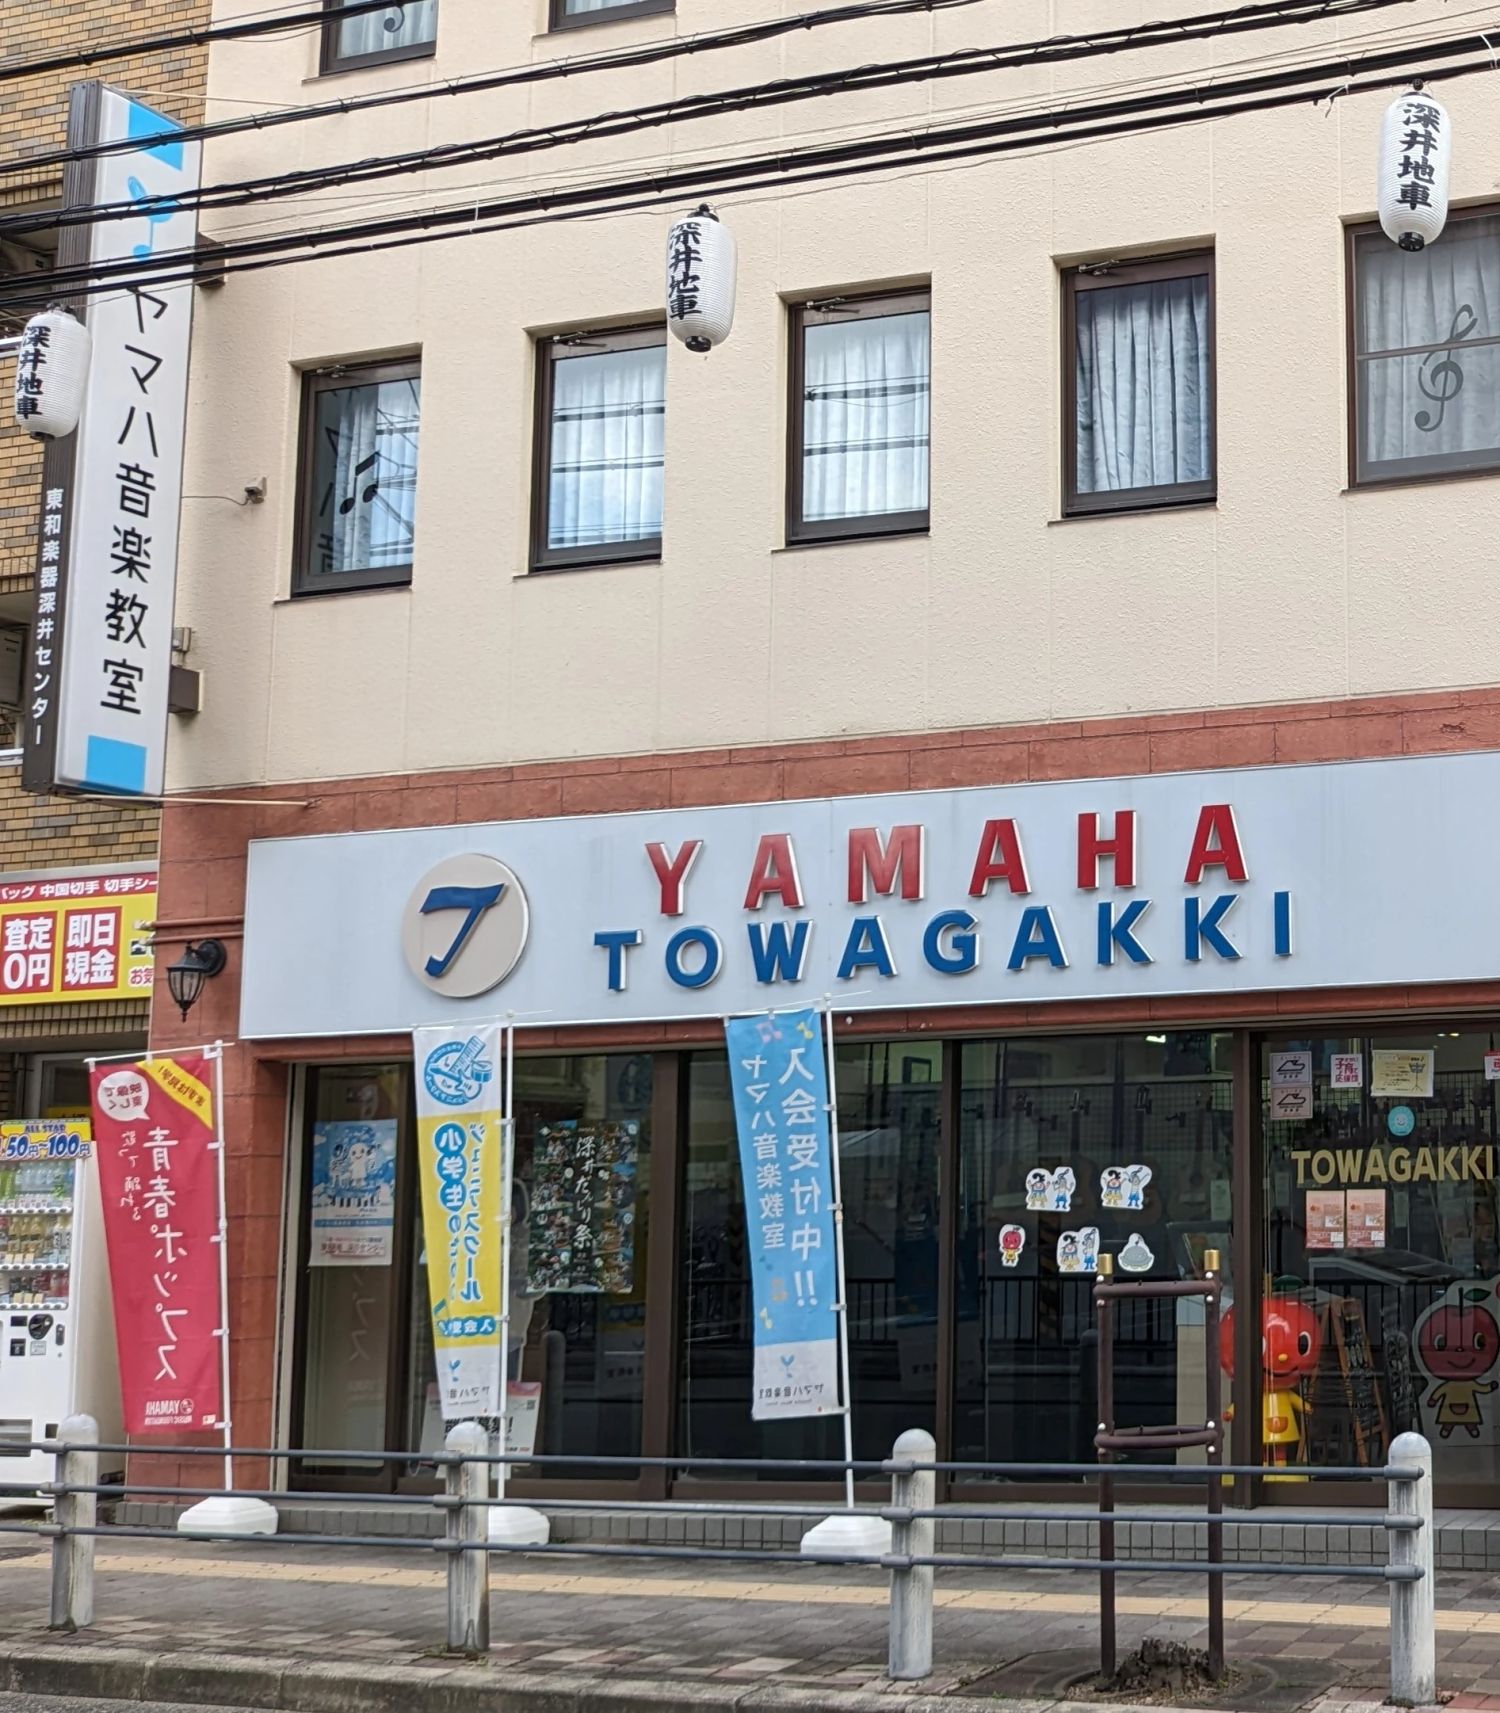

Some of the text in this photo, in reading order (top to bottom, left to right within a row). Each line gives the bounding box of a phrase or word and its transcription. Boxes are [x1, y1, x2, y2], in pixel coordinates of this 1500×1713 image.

[1395, 102, 1441, 211] 深井地車
[668, 221, 703, 320] 深井地車
[16, 325, 52, 420] 深井地車
[99, 285, 169, 715] ヤマハ音楽教室
[31, 488, 64, 745] 東和楽器深井センター
[40, 880, 100, 898] 中国切手
[645, 803, 1250, 917] YAMAHA
[3, 948, 116, 990] 0円 現金
[4, 916, 54, 951] 査定
[66, 911, 116, 948] 即日
[593, 890, 1293, 992] TOWAGAKKI
[1291, 1145, 1494, 1185] TOWAGAKKI
